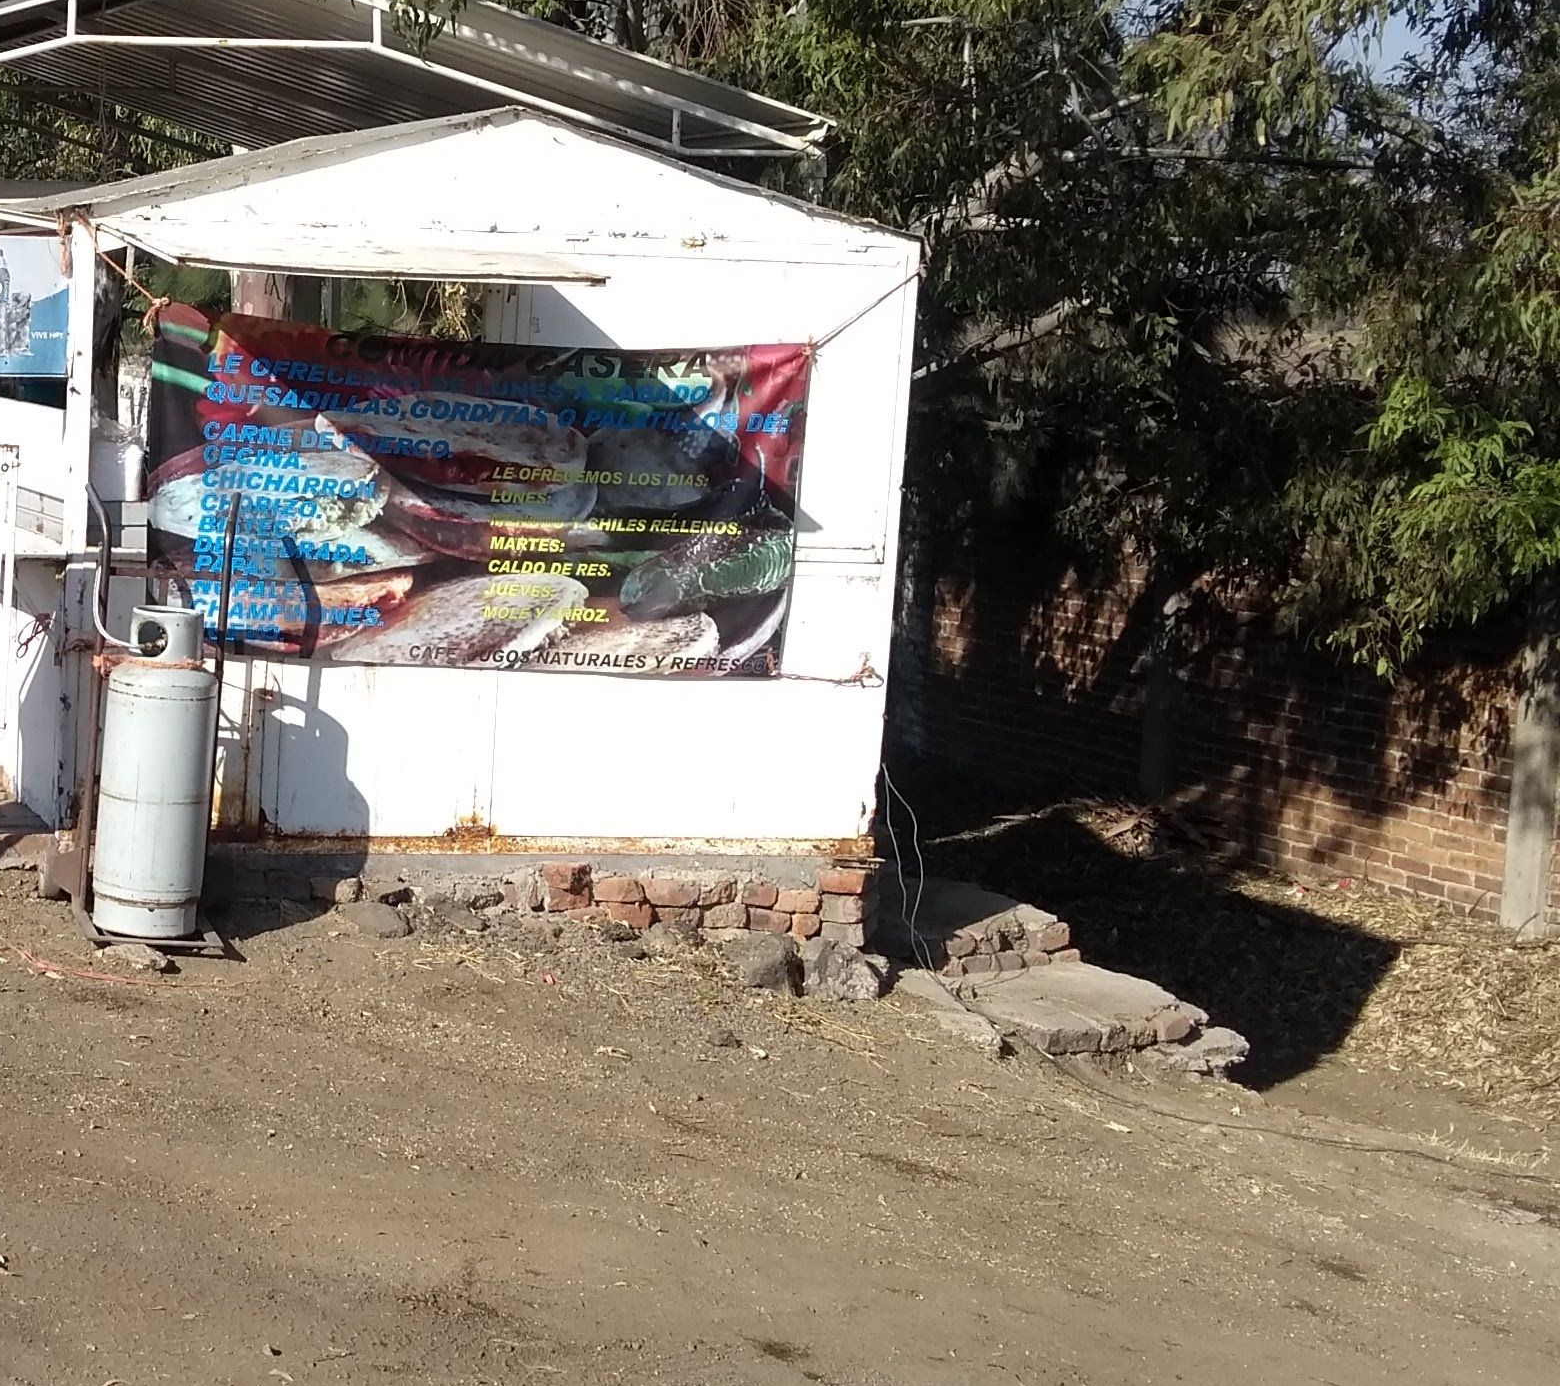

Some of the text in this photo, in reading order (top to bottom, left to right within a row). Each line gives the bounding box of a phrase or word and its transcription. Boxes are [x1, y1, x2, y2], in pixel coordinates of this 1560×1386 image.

[30, 331, 47, 339] VIVE
[207, 353, 243, 375] LE
[250, 356, 421, 391] OFRECEMOS
[526, 351, 712, 378] CASERA
[557, 408, 577, 428] O
[745, 412, 789, 435] DE:
[203, 421, 294, 447] CARNE
[301, 430, 335, 450] DE
[202, 444, 307, 471] CECINA.
[492, 466, 709, 488] LE OFRECEMOS LOS DIAS:
[491, 489, 551, 504] LUNES:
[587, 517, 646, 533] CHILES
[650, 518, 742, 535] RELLENOS.
[490, 535, 565, 553] MARTES:
[488, 559, 611, 577] CALDO DE RES.
[483, 606, 529, 620] MOLE
[534, 606, 546, 620] Y
[538, 648, 647, 670] NATURALES
[655, 655, 666, 669] Y
[670, 656, 777, 674] REFRESCO
